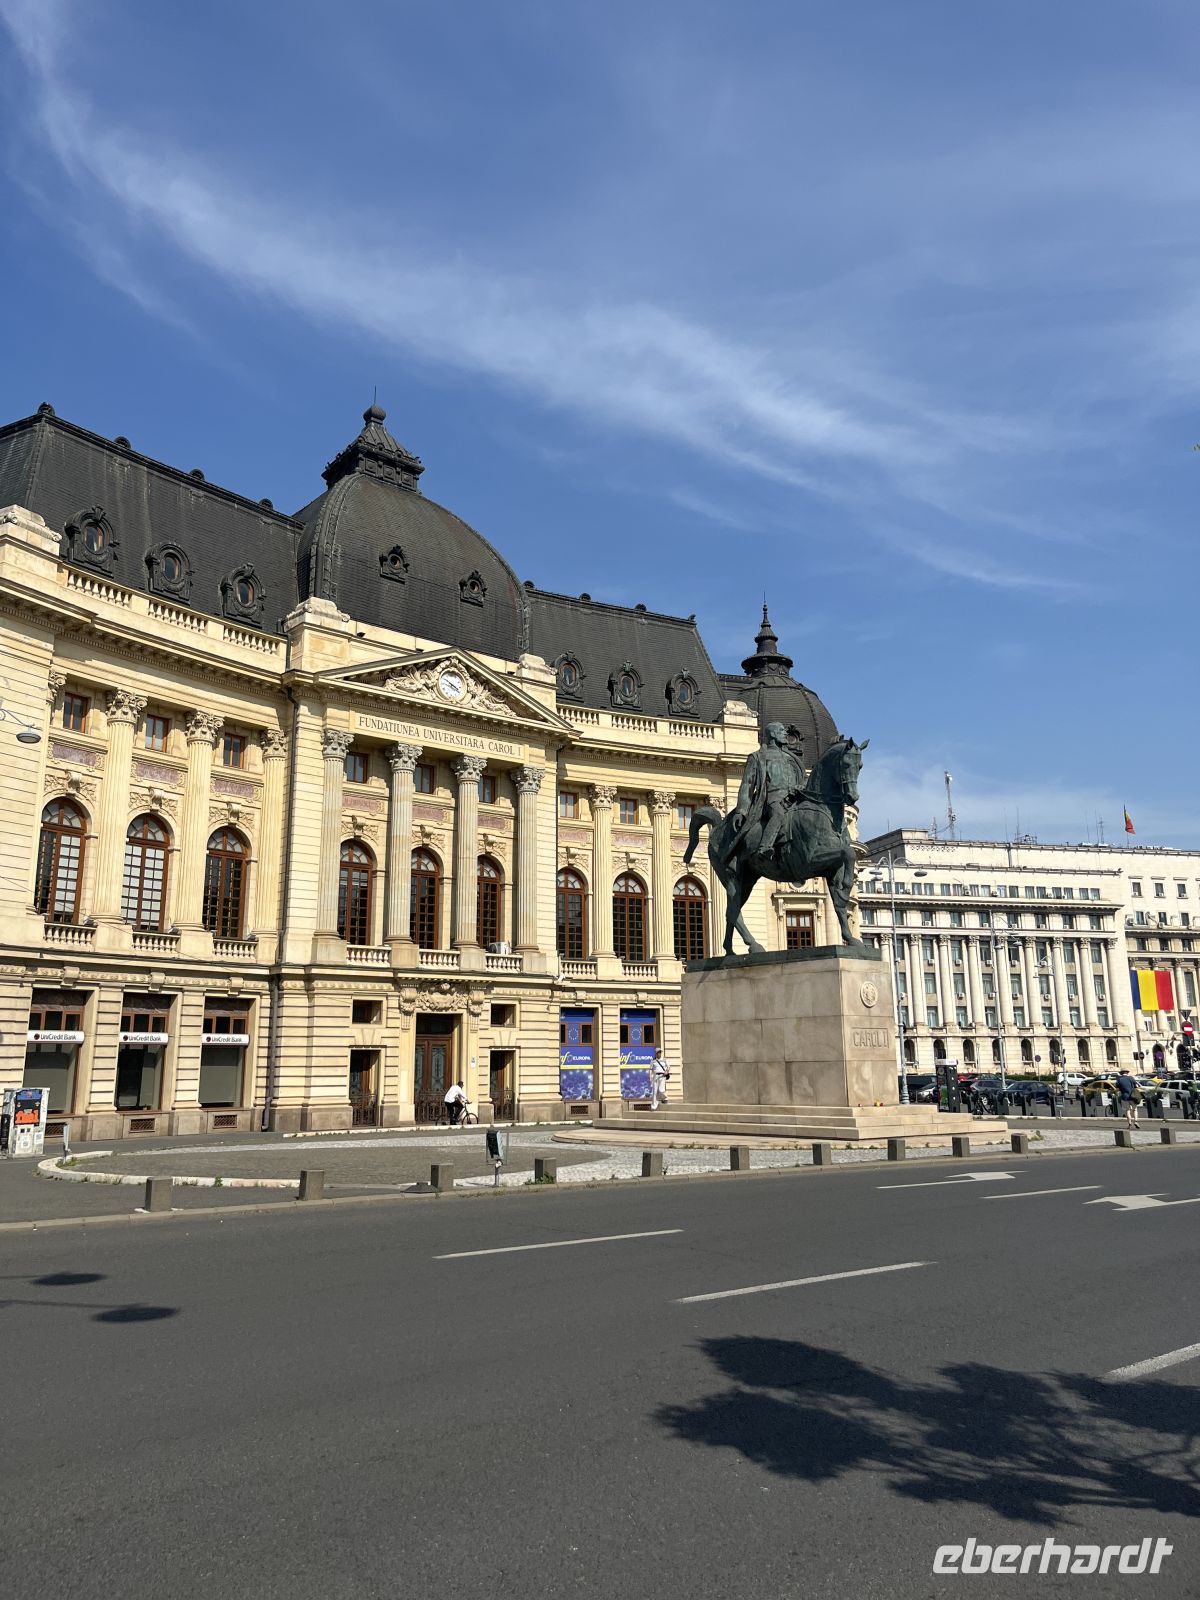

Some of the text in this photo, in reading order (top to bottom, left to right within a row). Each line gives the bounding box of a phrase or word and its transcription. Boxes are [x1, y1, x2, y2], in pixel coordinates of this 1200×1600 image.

[359, 716, 420, 737] FUNDATIUNEA
[423, 730, 485, 749] UNIVERSITARA
[488, 741, 515, 756] CAROL
